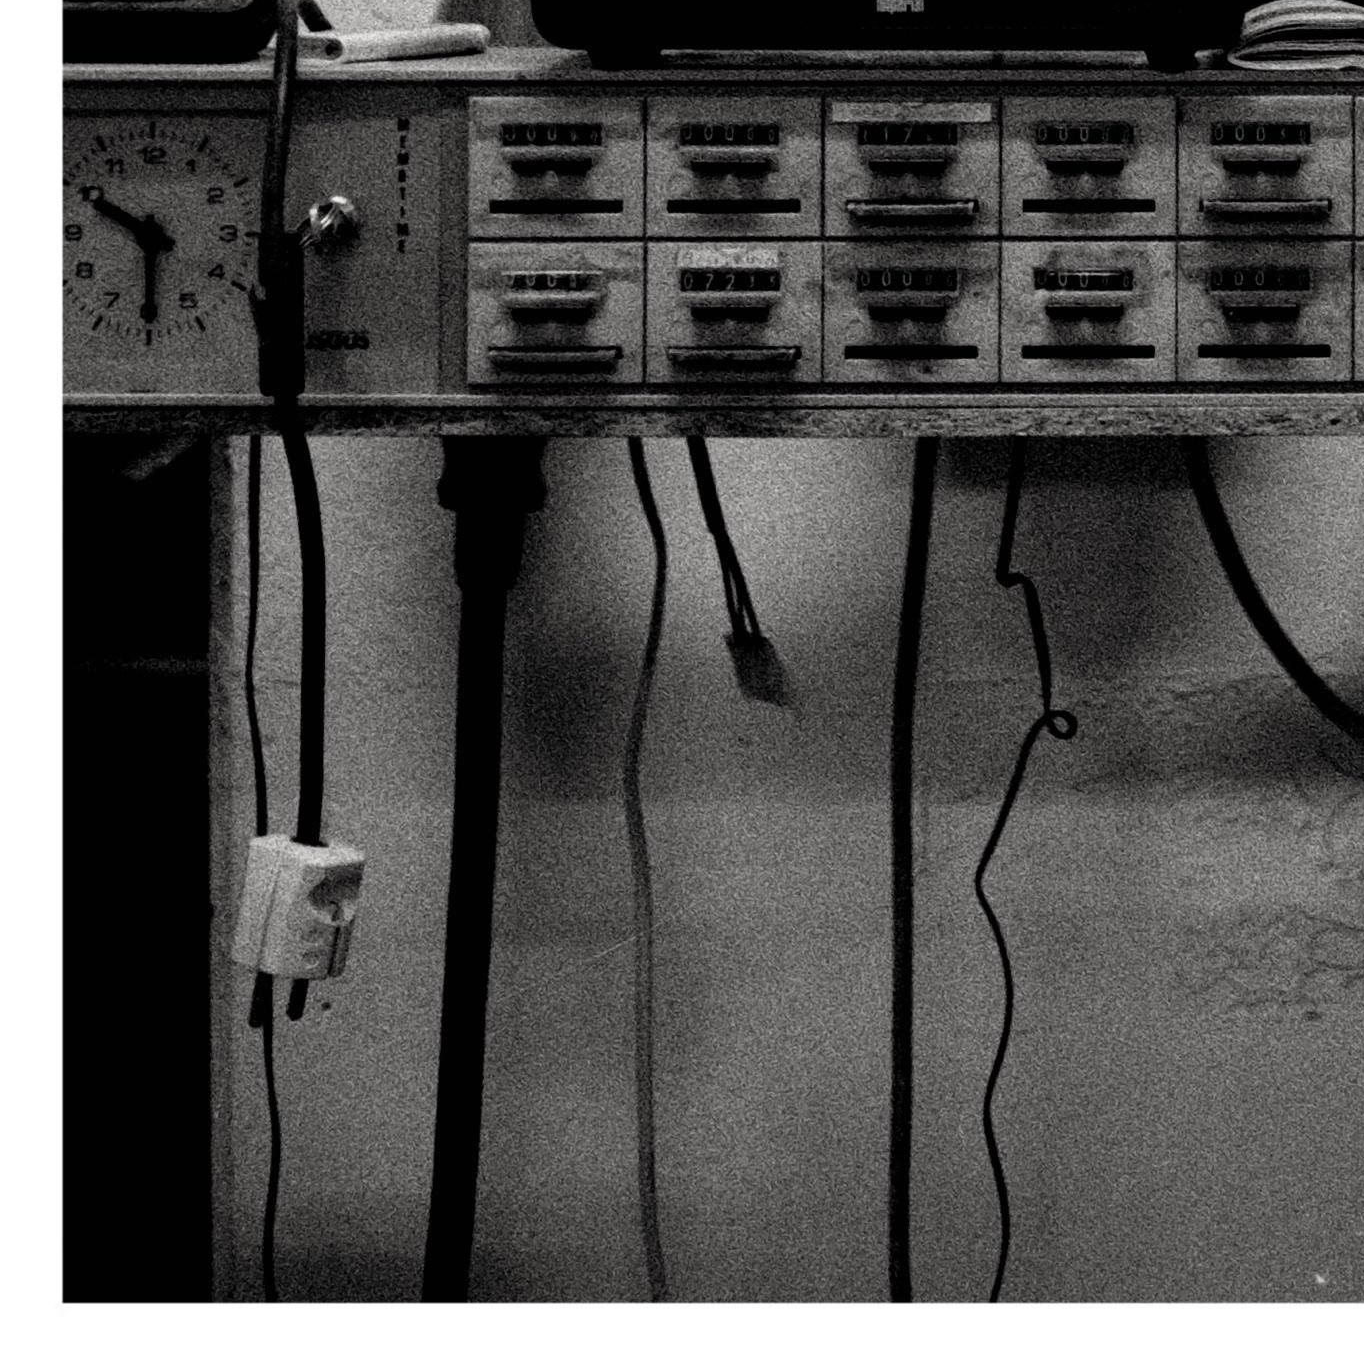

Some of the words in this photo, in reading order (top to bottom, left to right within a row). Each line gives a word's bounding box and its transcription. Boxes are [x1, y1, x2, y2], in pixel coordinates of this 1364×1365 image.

[137, 146, 167, 165] 12
[105, 158, 125, 175] 11
[185, 158, 197, 174] 1
[206, 187, 225, 205] 2
[64, 224, 83, 242] 9
[218, 224, 238, 243] 3
[75, 262, 94, 279] 8
[207, 263, 225, 279] 4
[103, 292, 120, 308] 7
[178, 292, 198, 310] 5
